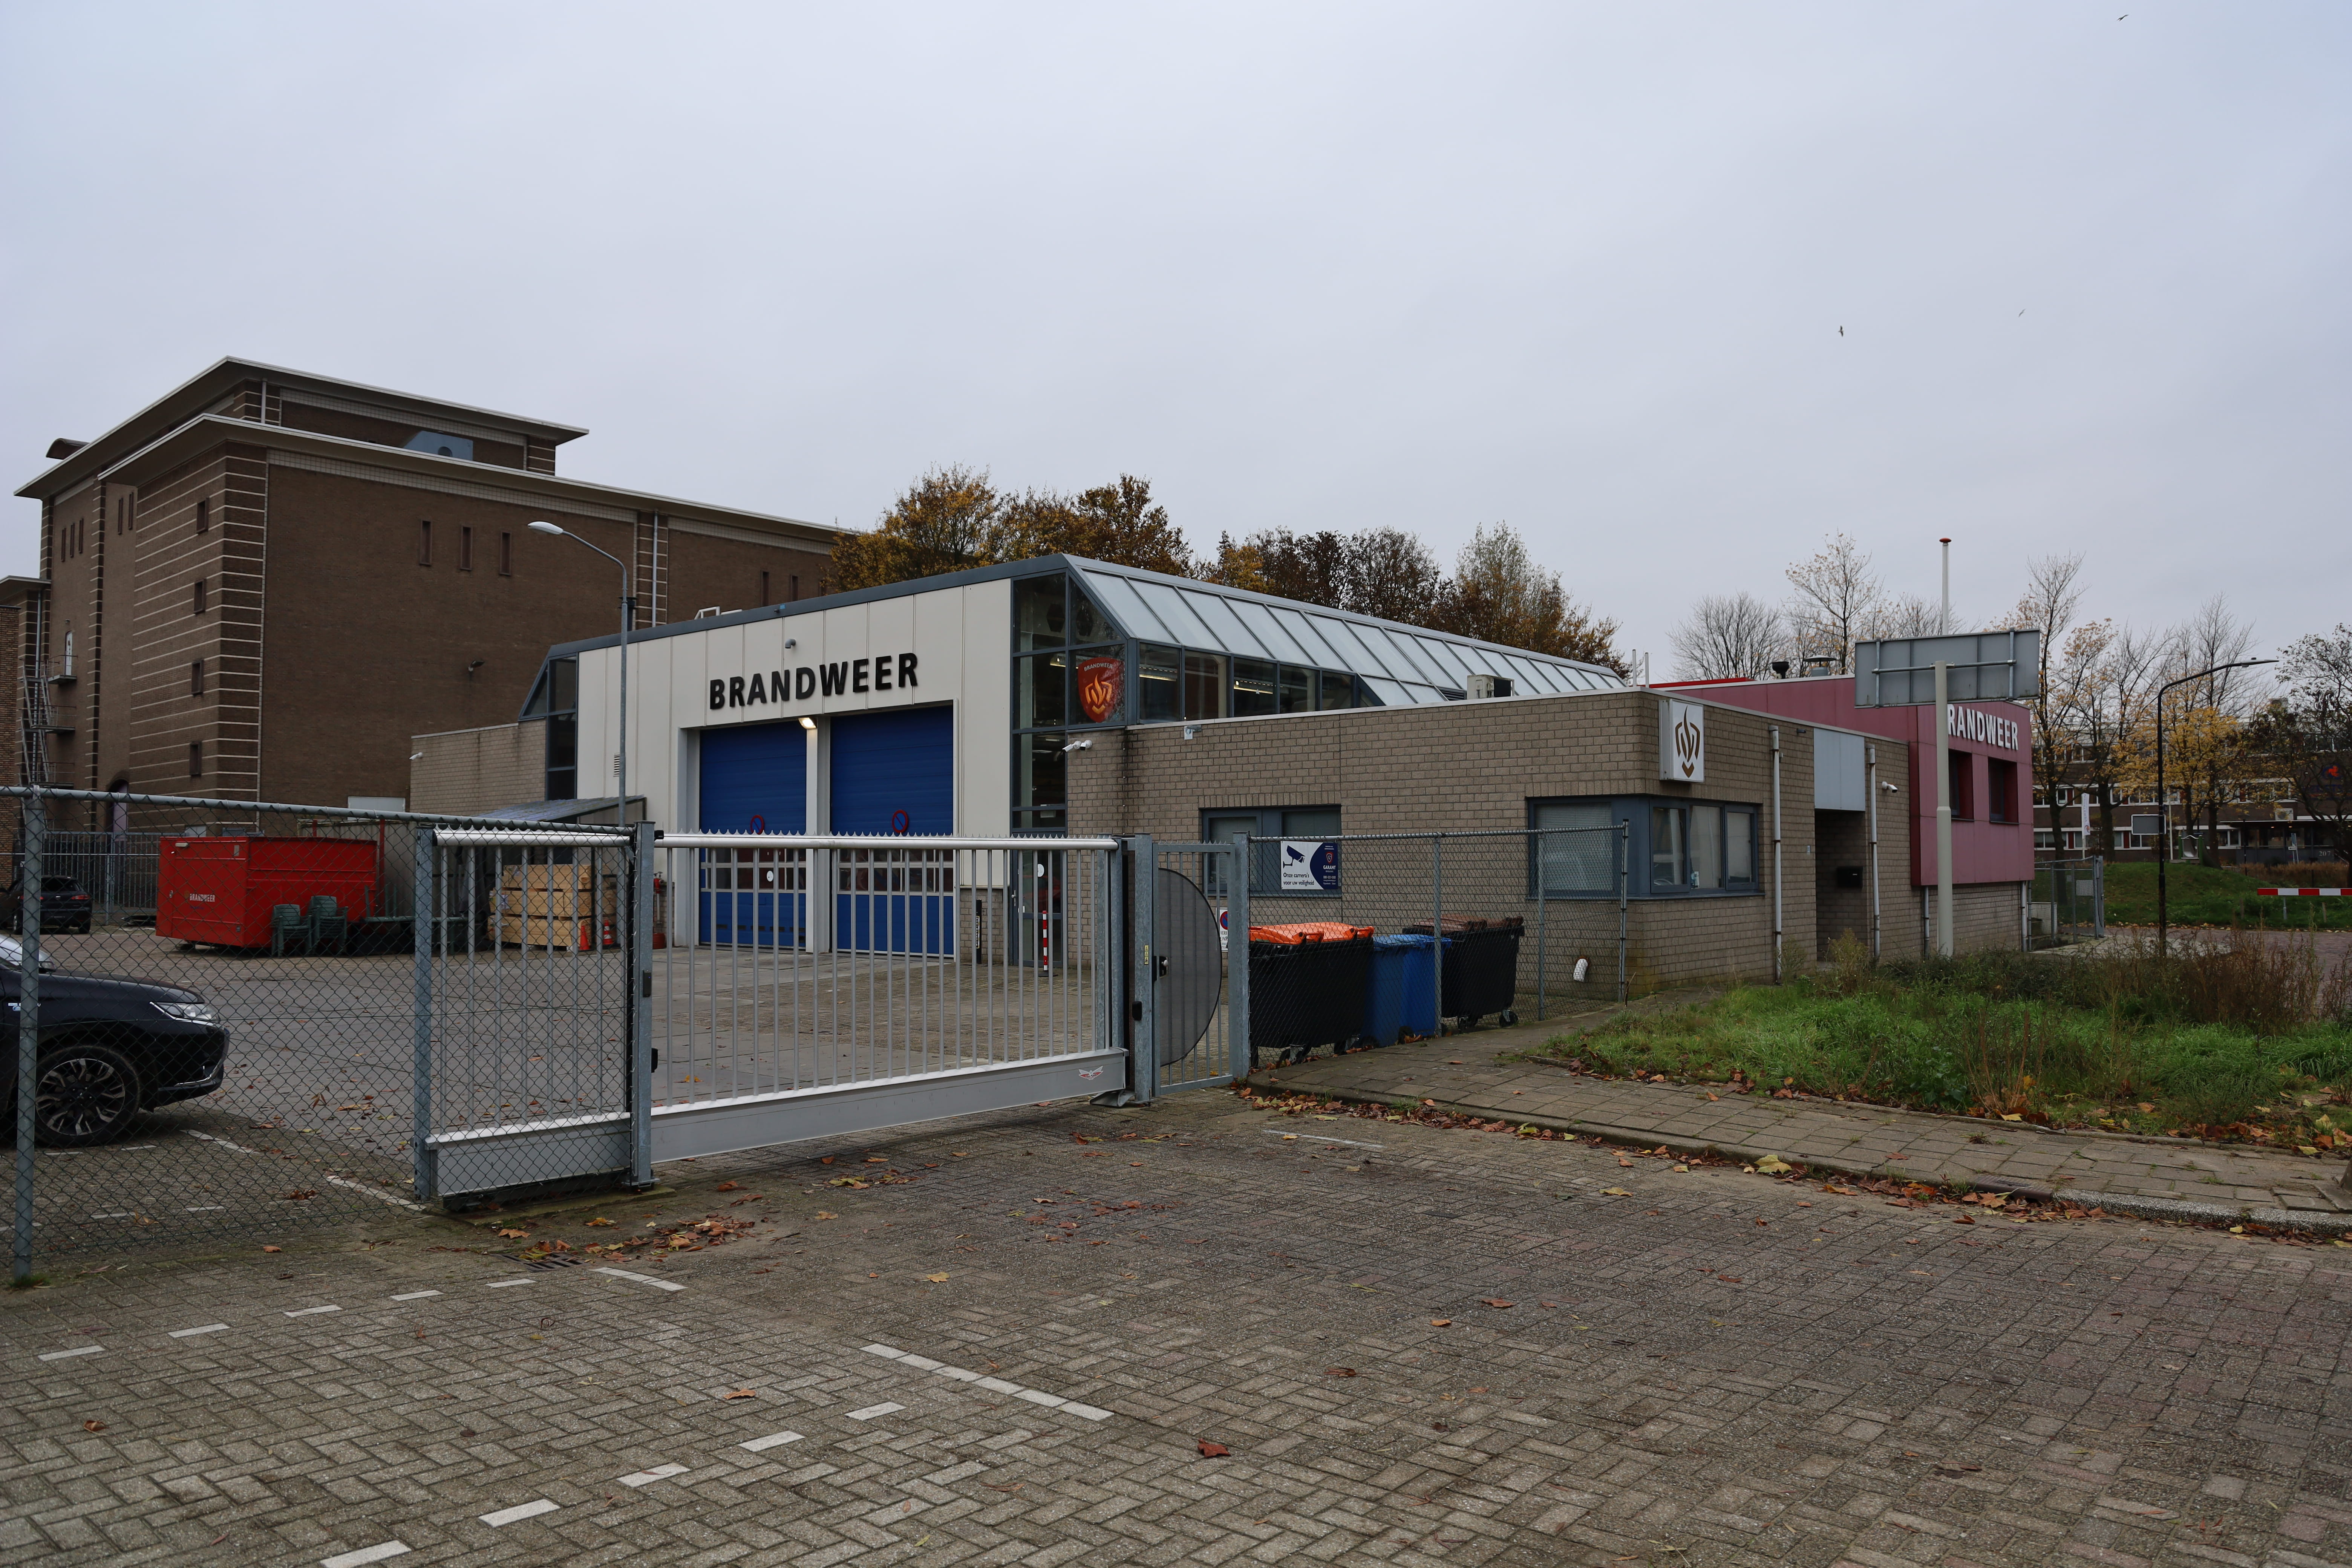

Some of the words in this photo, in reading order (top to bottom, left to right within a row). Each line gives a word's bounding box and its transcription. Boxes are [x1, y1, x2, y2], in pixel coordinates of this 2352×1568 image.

[710, 652, 918, 710] BRANDWEER
[1083, 662, 1113, 672] BRANDWEER
[1947, 703, 2019, 751] RANDWEER
[190, 893, 215, 902] BRANDWEER
